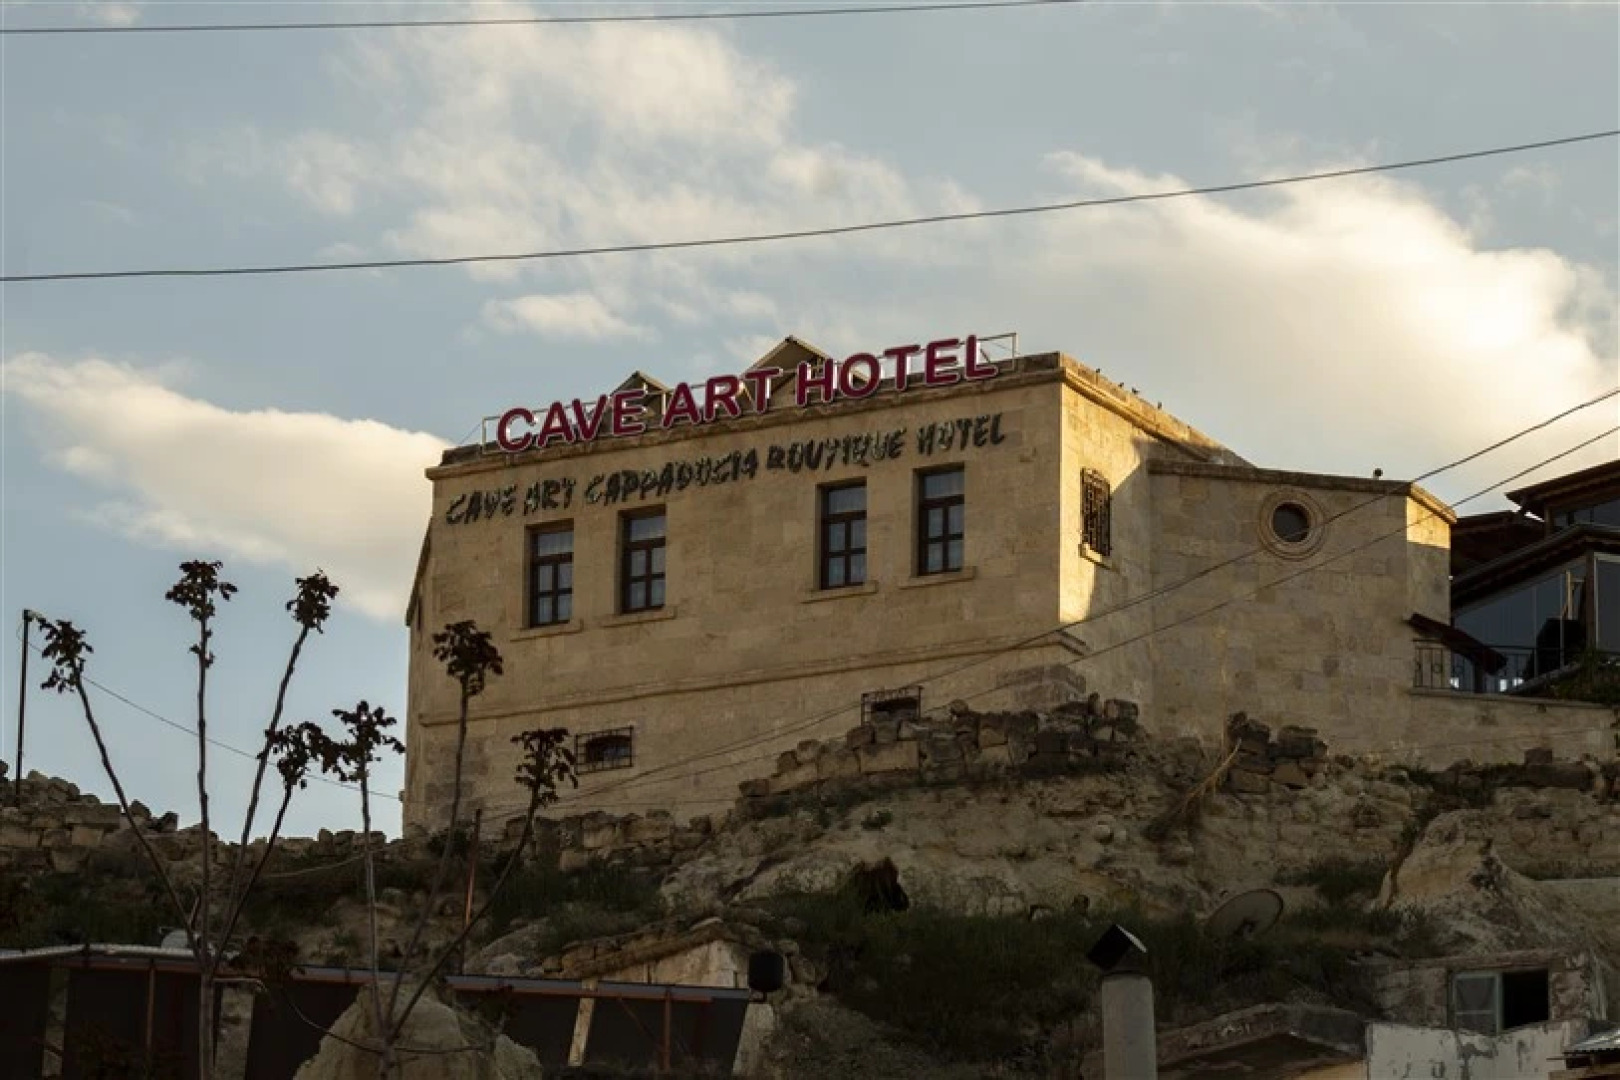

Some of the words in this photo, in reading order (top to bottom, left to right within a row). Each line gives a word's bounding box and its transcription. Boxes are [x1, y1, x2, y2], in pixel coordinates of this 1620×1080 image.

[497, 390, 646, 452] CAVE
[662, 367, 783, 428] ART
[795, 334, 999, 407] HOTEL
[446, 483, 517, 525] CAVE
[523, 477, 577, 516] ART
[584, 446, 758, 506] CAPPADOCIA
[766, 427, 908, 474] BOUTIQUE
[916, 412, 1006, 455] HOTEL
